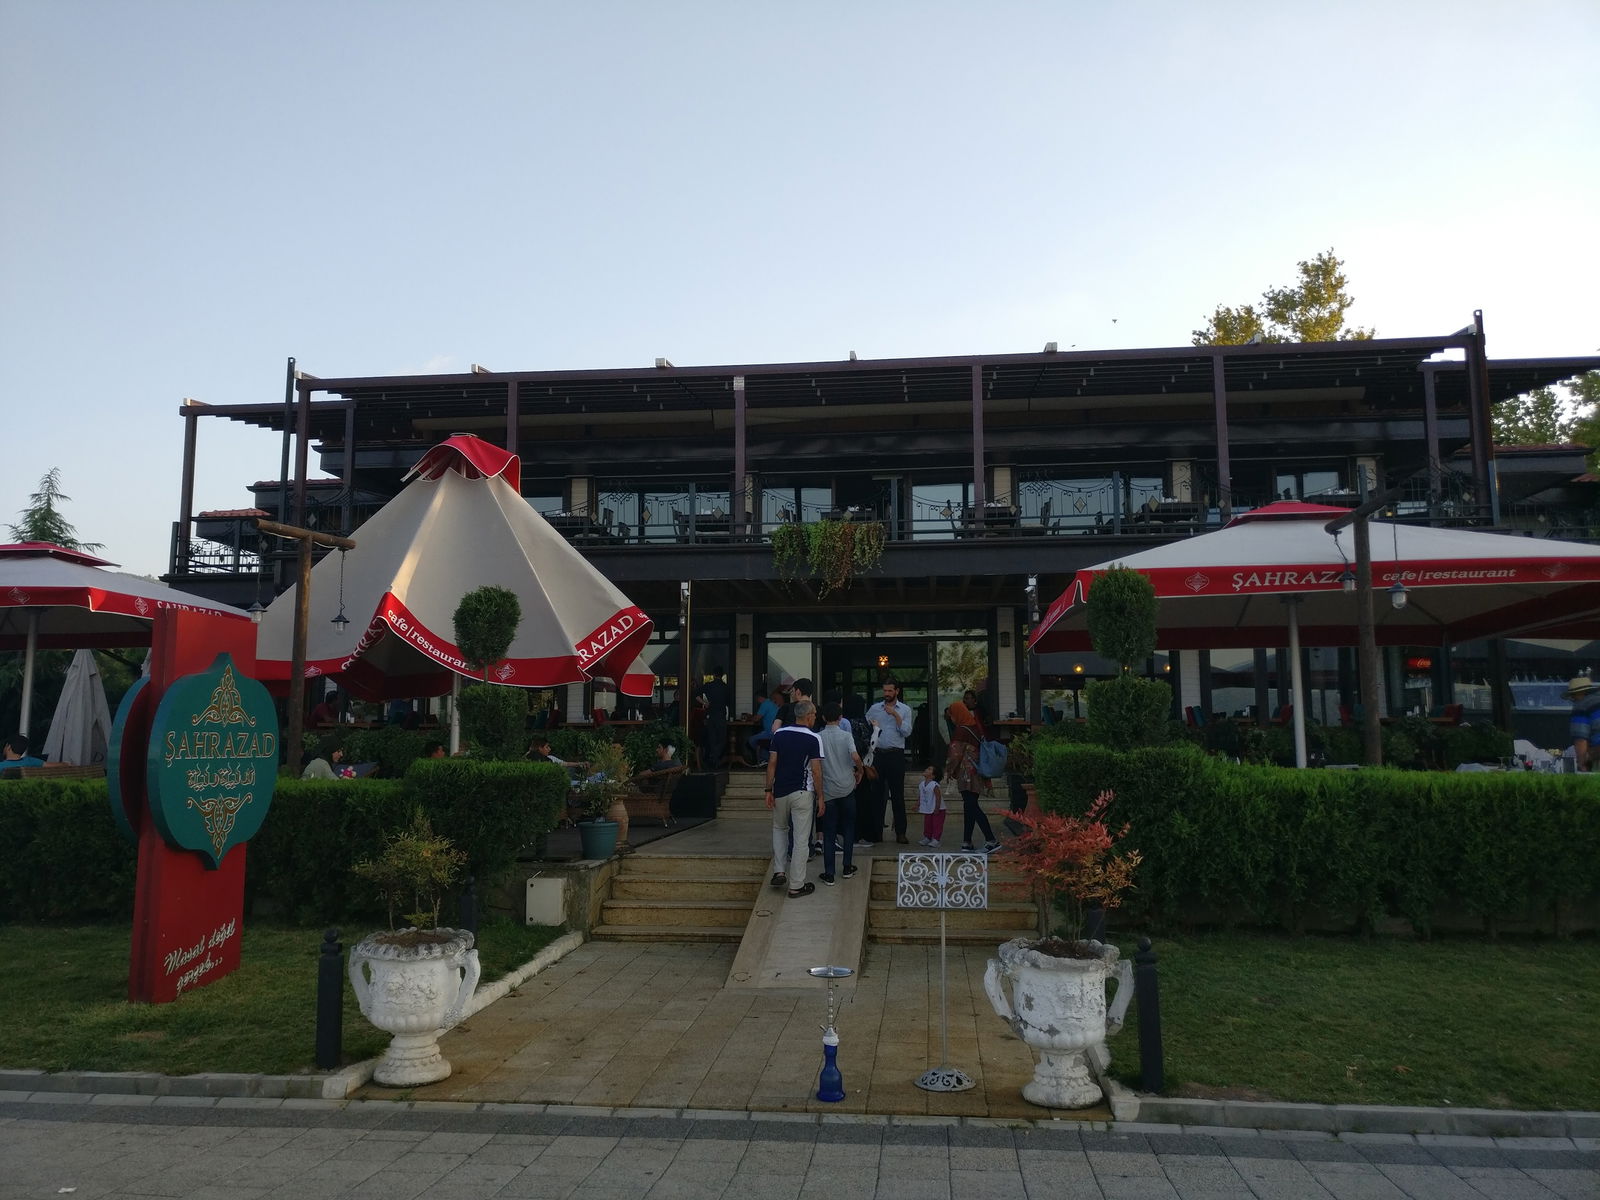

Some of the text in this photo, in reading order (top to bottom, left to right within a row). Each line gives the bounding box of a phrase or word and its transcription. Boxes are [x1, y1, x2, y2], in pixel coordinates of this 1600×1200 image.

[1232, 571, 1345, 591] ŞAHRAZ
[578, 615, 634, 664] RAZAD
[165, 731, 275, 767] ŞAHRAZAD
[164, 935, 205, 976] Masal
